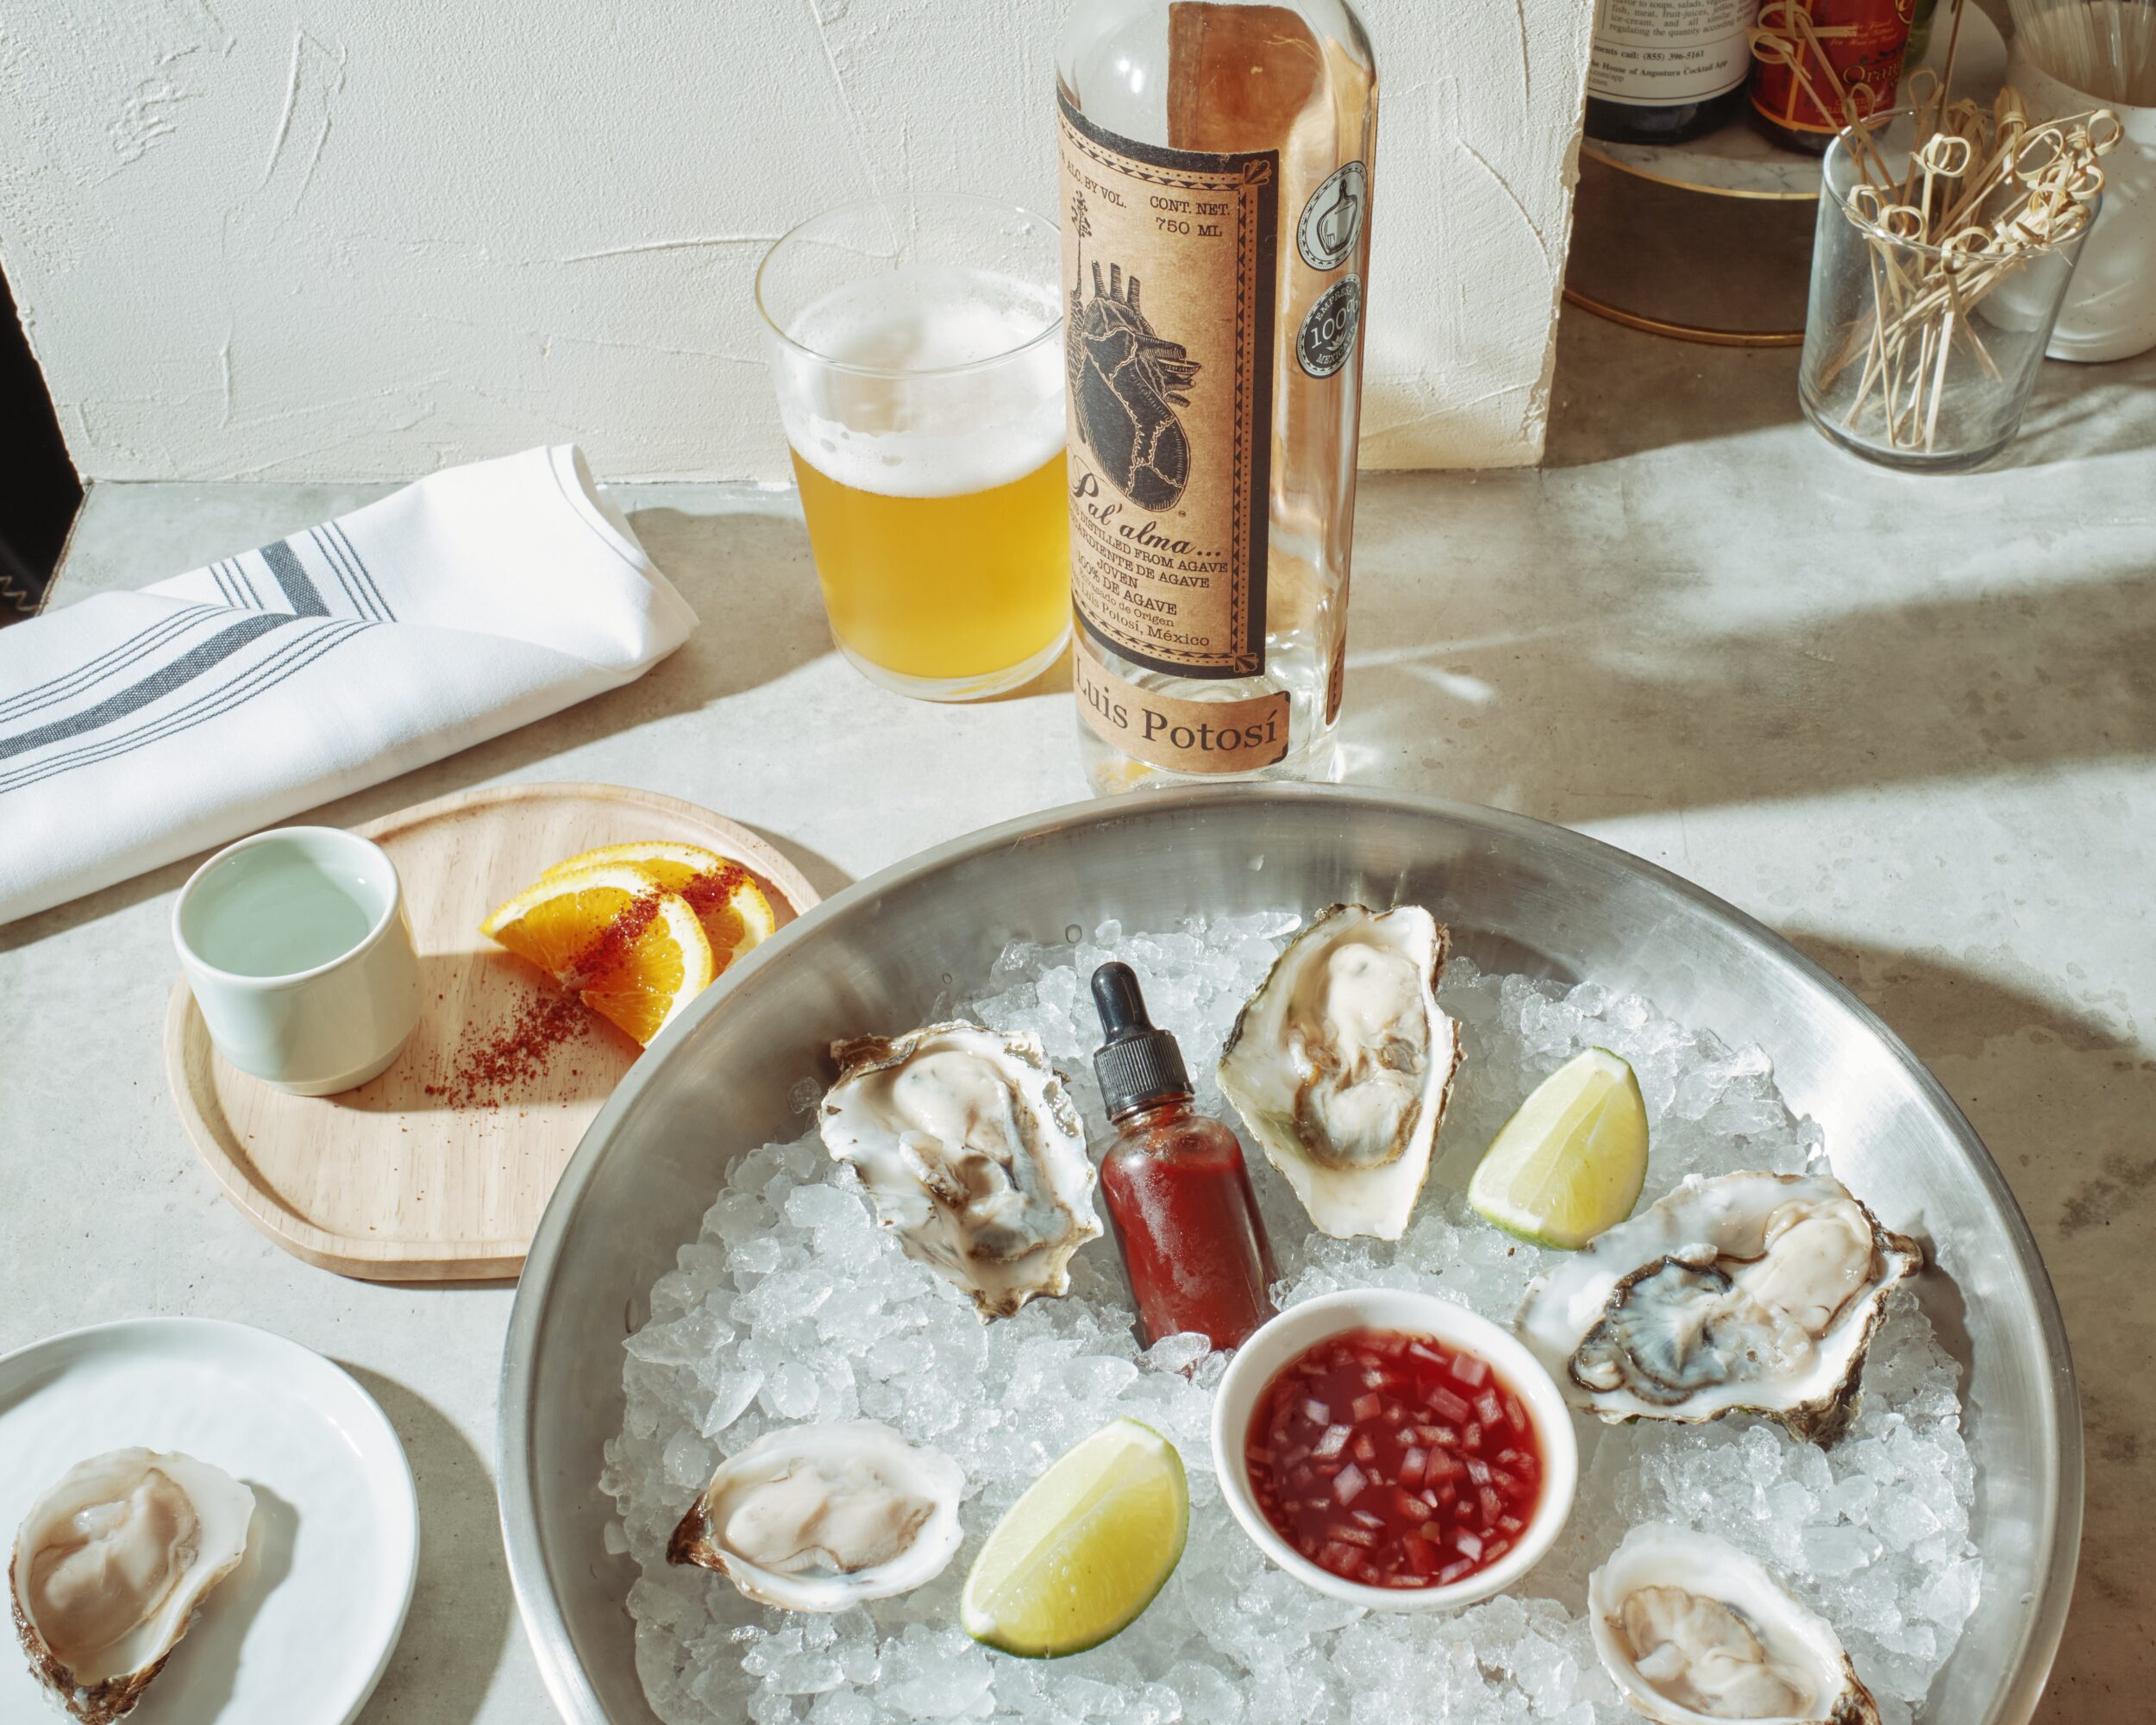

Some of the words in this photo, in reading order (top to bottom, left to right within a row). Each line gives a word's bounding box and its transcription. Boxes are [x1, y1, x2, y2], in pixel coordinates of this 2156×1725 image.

[1611, 13, 1655, 27] ice-cream,
[1688, 17, 1699, 26] all
[1612, 4, 1630, 16] fish,
[1635, 9, 1658, 18] meat,
[1609, 23, 1650, 37] regulating
[1653, 28, 1665, 36] the
[1668, 28, 1700, 38] quantity
[1594, 45, 1618, 56] ments
[1621, 50, 1639, 60] call:
[1643, 52, 1665, 61] (855)
[1668, 49, 1704, 61] 396-5161
[1591, 60, 1600, 68] he
[1602, 62, 1626, 74] House
[1640, 69, 1681, 78] Angostura
[1683, 63, 1713, 76] Cocktail
[1714, 60, 1728, 69] App
[1067, 160, 1083, 184] ALC.
[1084, 176, 1099, 194] BY
[1100, 185, 1127, 209] VOL.
[1150, 195, 1193, 214] CONT.
[1195, 203, 1231, 216] NET.
[1156, 216, 1191, 235] 750
[1197, 224, 1223, 237] ML
[1310, 293, 1358, 349] 100%
[1080, 511, 1131, 555] DISTILLED
[1134, 548, 1175, 568] FROM
[1176, 561, 1229, 574] AGAVE
[1078, 551, 1100, 583] 100%
[1103, 574, 1120, 596] DE
[1123, 590, 1178, 616] AGAVE
[1096, 558, 1138, 589] JOVEN
[1136, 563, 1155, 580] DE
[1158, 572, 1211, 589] AGAVE
[1101, 602, 1144, 636] Potosí,
[1146, 624, 1210, 646] México
[1119, 599, 1131, 614] de
[1134, 609, 1175, 627] Origen
[1076, 656, 1129, 730] Luis
[1141, 709, 1277, 752] Potosí
